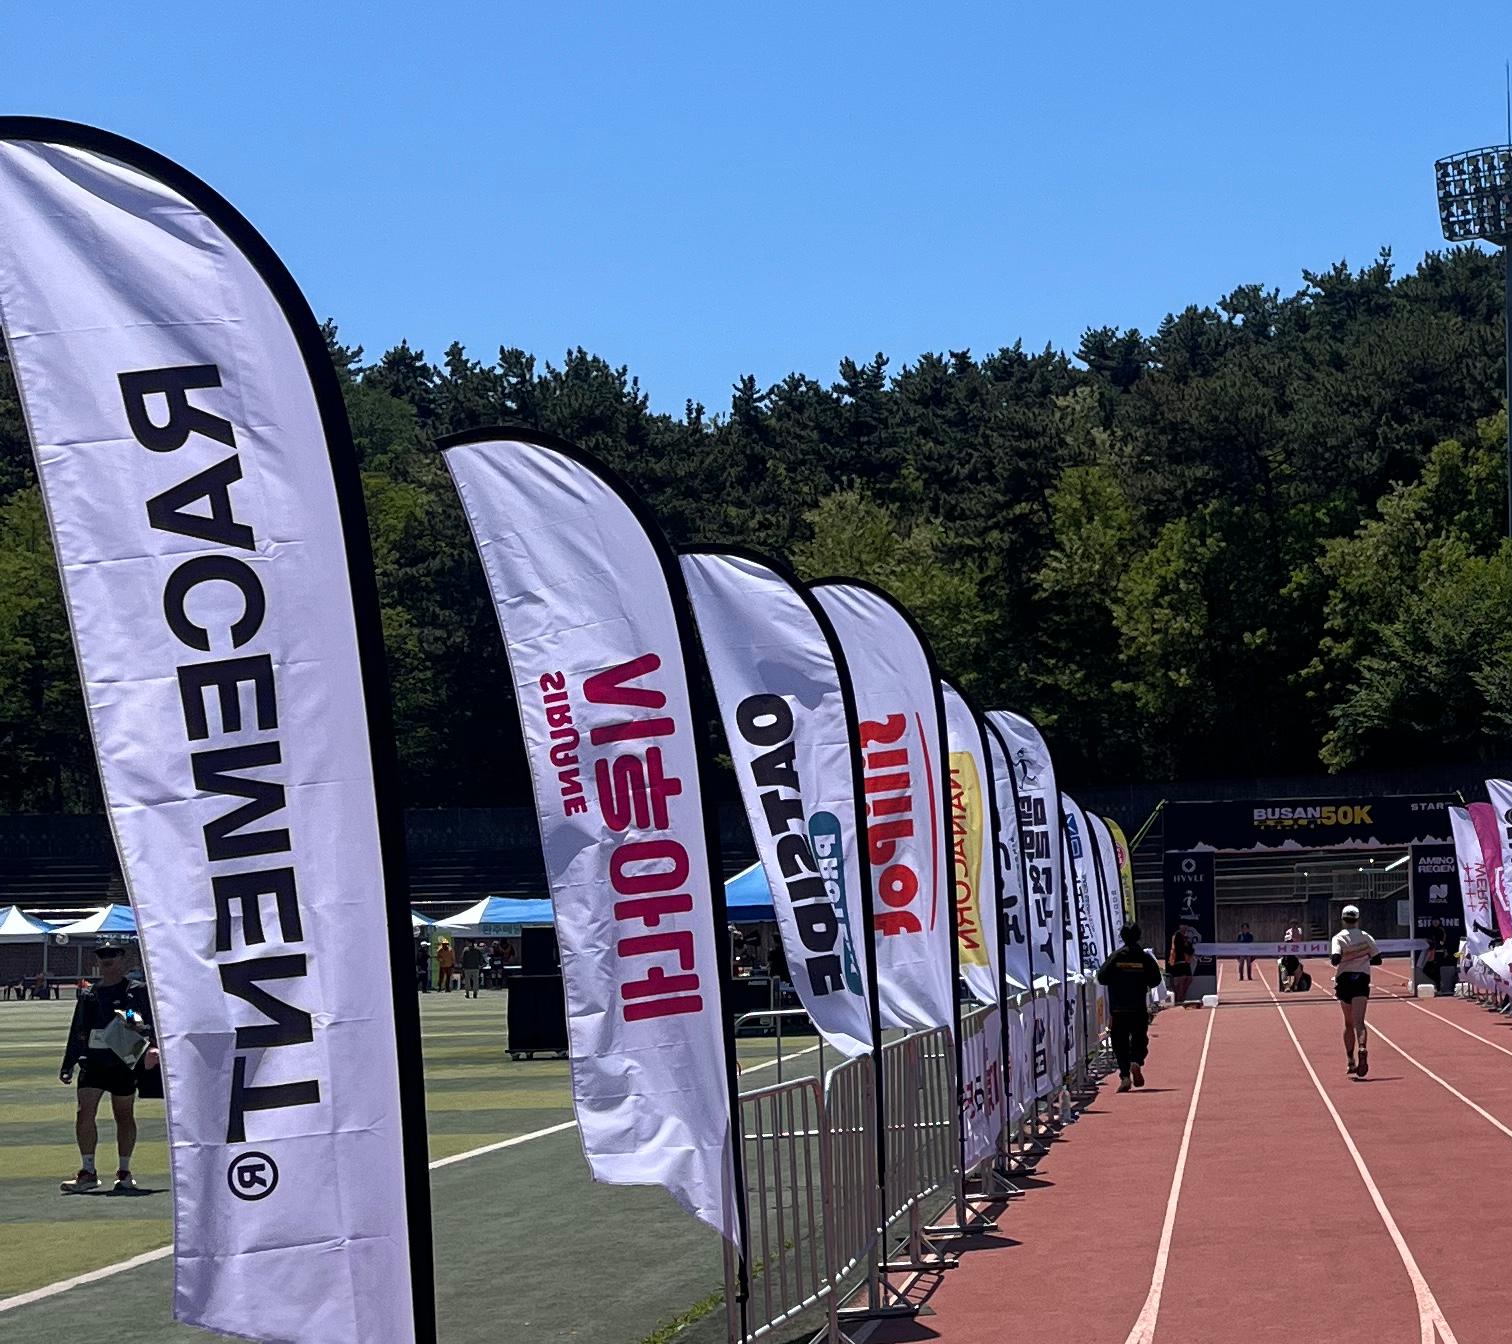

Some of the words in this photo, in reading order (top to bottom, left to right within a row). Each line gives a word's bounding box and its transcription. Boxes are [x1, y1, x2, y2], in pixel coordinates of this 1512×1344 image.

[1410, 801, 1453, 812] STAR
[1418, 856, 1455, 865] AMINO
[1417, 864, 1456, 873] REGEN
